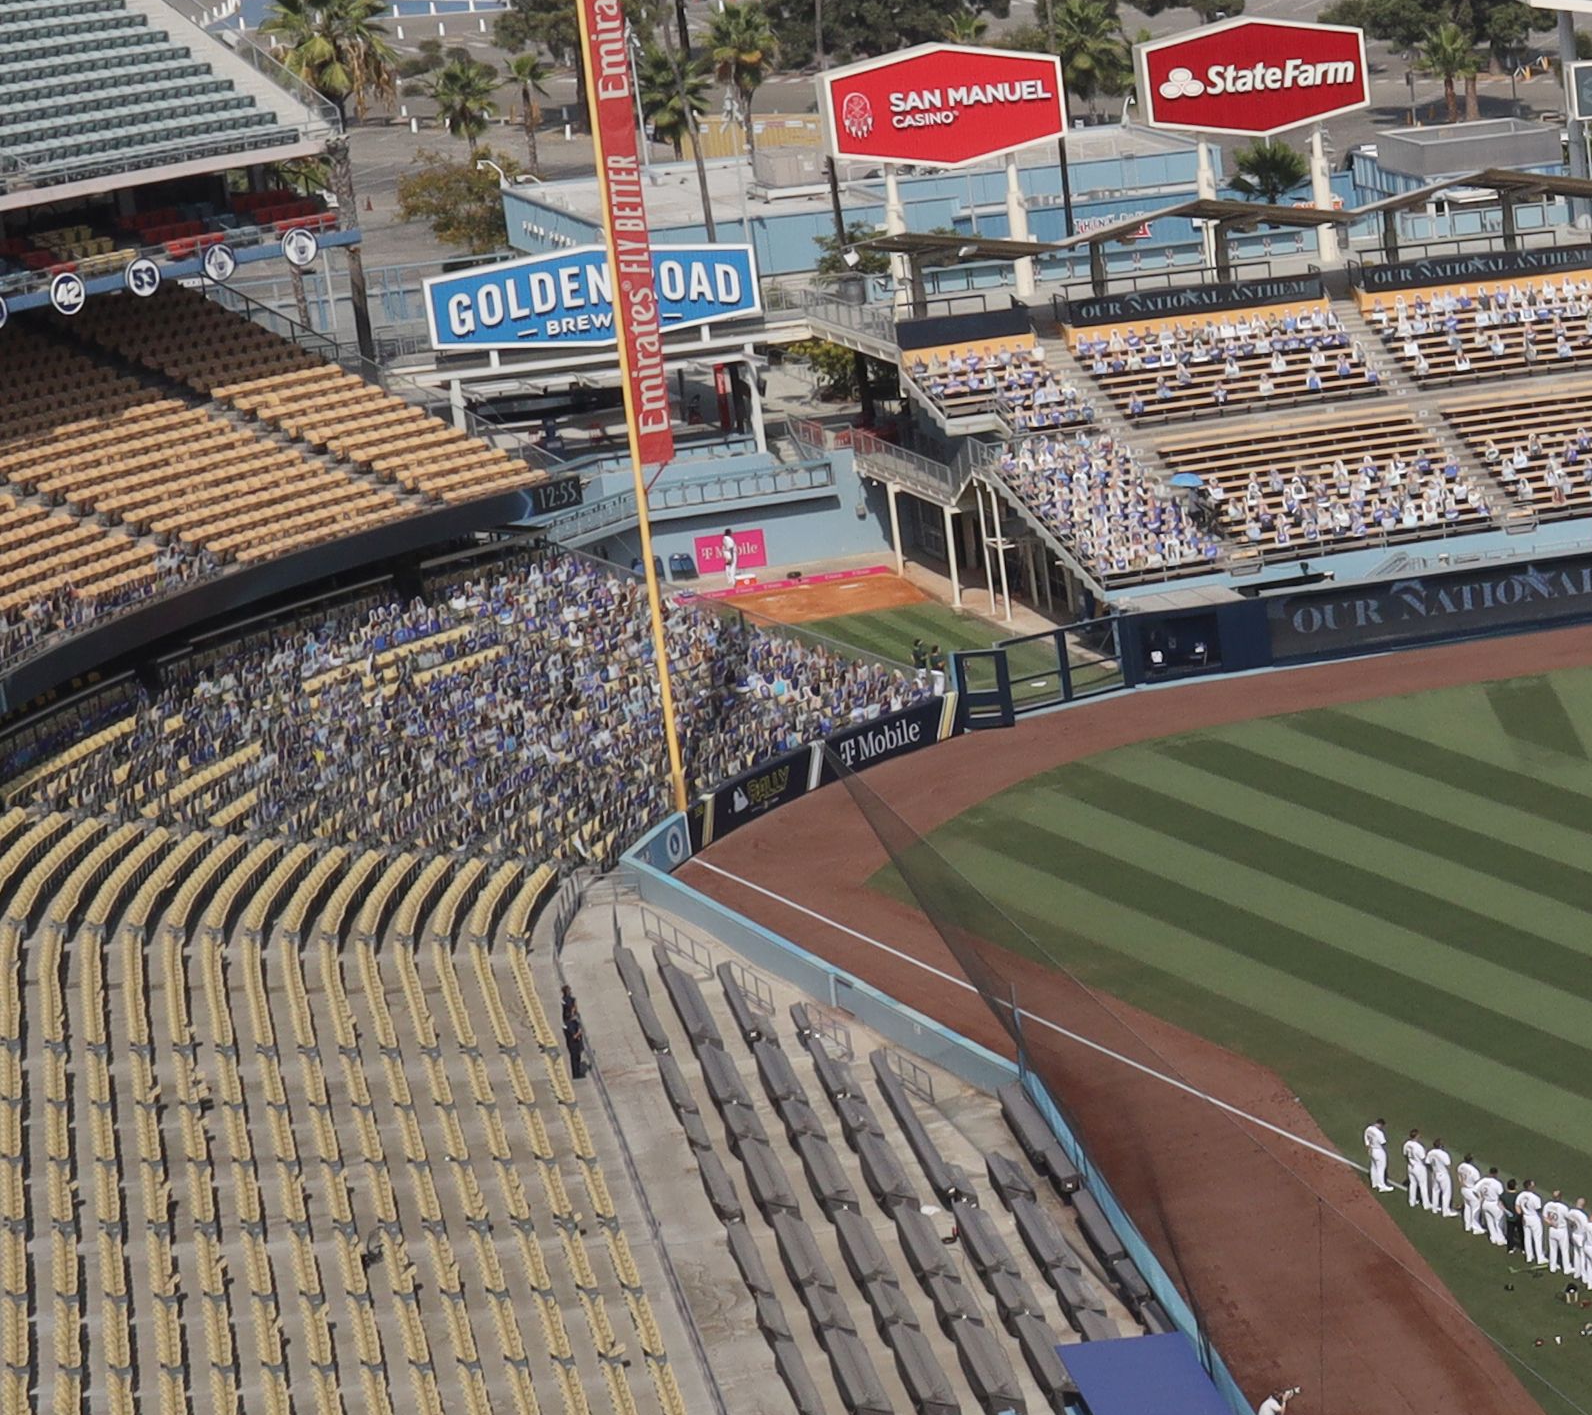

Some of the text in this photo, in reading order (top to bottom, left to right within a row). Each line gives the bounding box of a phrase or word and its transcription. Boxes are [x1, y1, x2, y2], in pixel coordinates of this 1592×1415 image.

[889, 80, 1051, 113] SAN MANUEL
[892, 110, 953, 128] CASINO
[607, 155, 645, 232] BETTER
[617, 238, 649, 274] FLY
[1374, 249, 1590, 284] OUR NATIONAL ANTHEM
[56, 283, 81, 306] 42
[133, 267, 157, 288] 53
[448, 260, 741, 335] GOLDEN OAD
[1082, 279, 1306, 319] OUR NATIONAL ANTHEM
[539, 481, 576, 509] 12:55
[1293, 599, 1383, 634] OUR
[859, 720, 920, 762] Mobile
